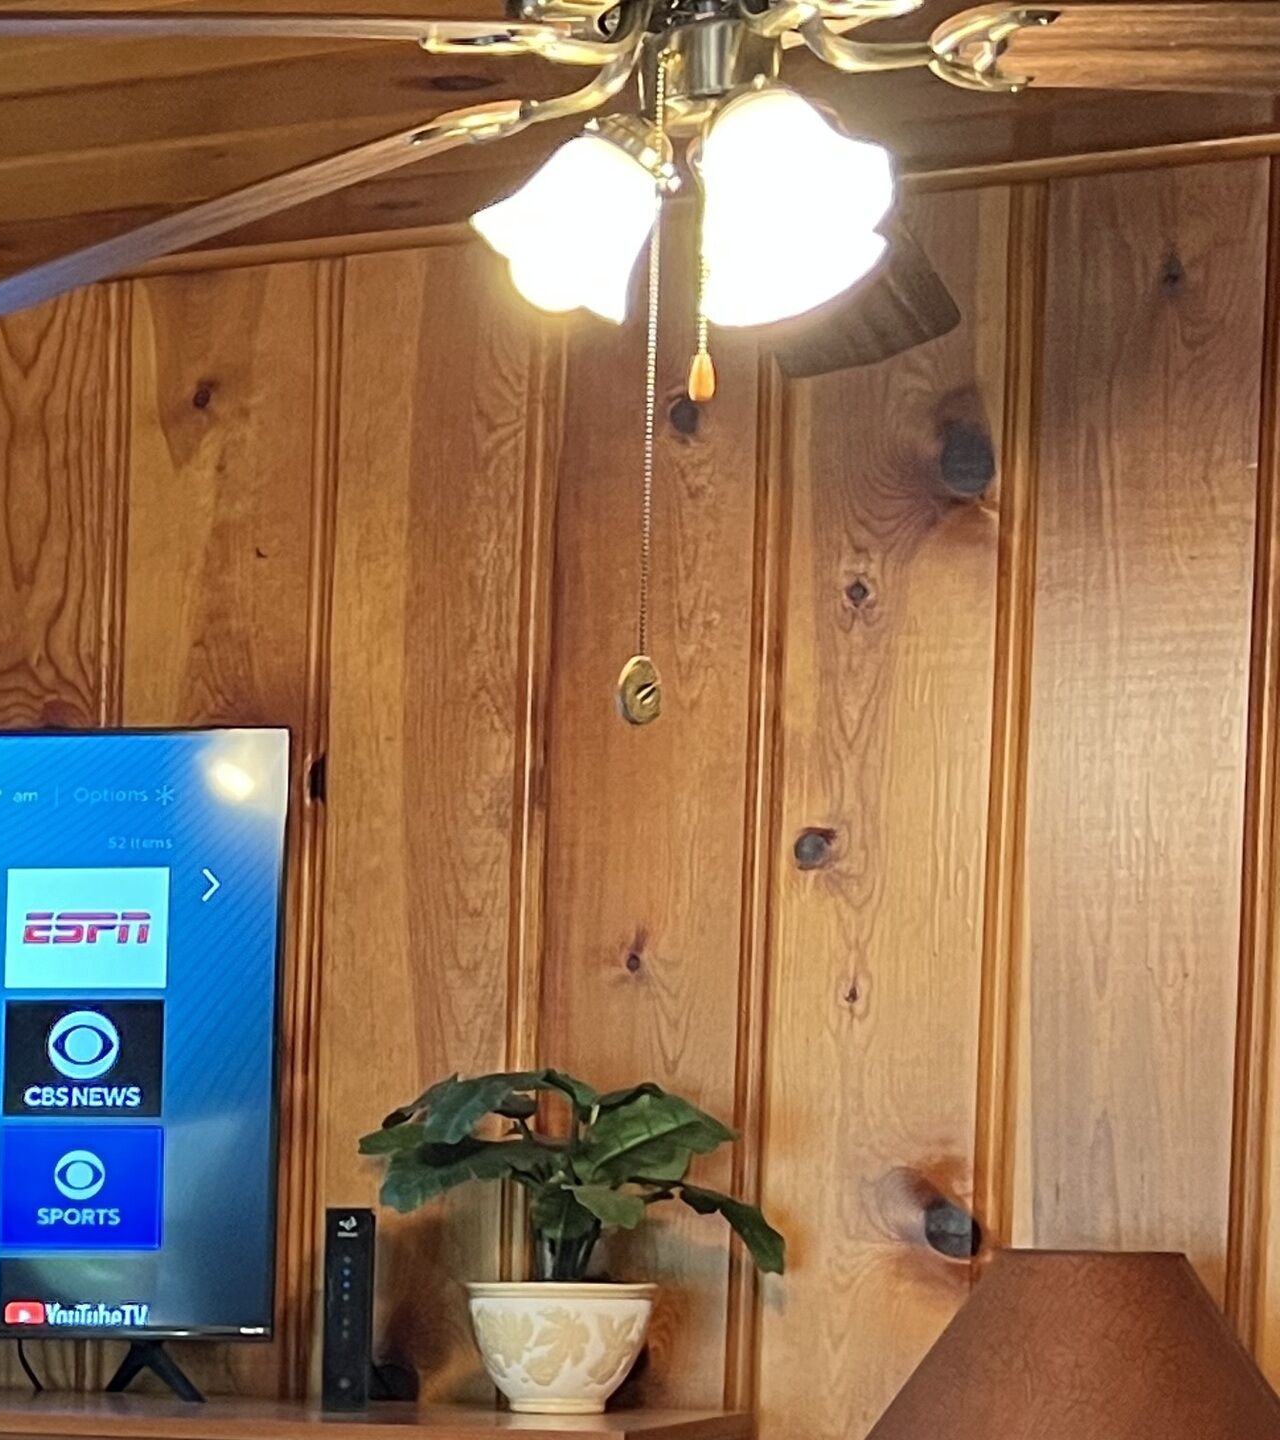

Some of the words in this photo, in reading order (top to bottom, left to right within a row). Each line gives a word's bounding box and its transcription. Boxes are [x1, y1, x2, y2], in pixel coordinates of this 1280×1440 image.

[12, 791, 38, 803] am
[73, 786, 149, 804] Options
[23, 912, 151, 944] ESPN
[37, 1208, 121, 1226] SPORTS
